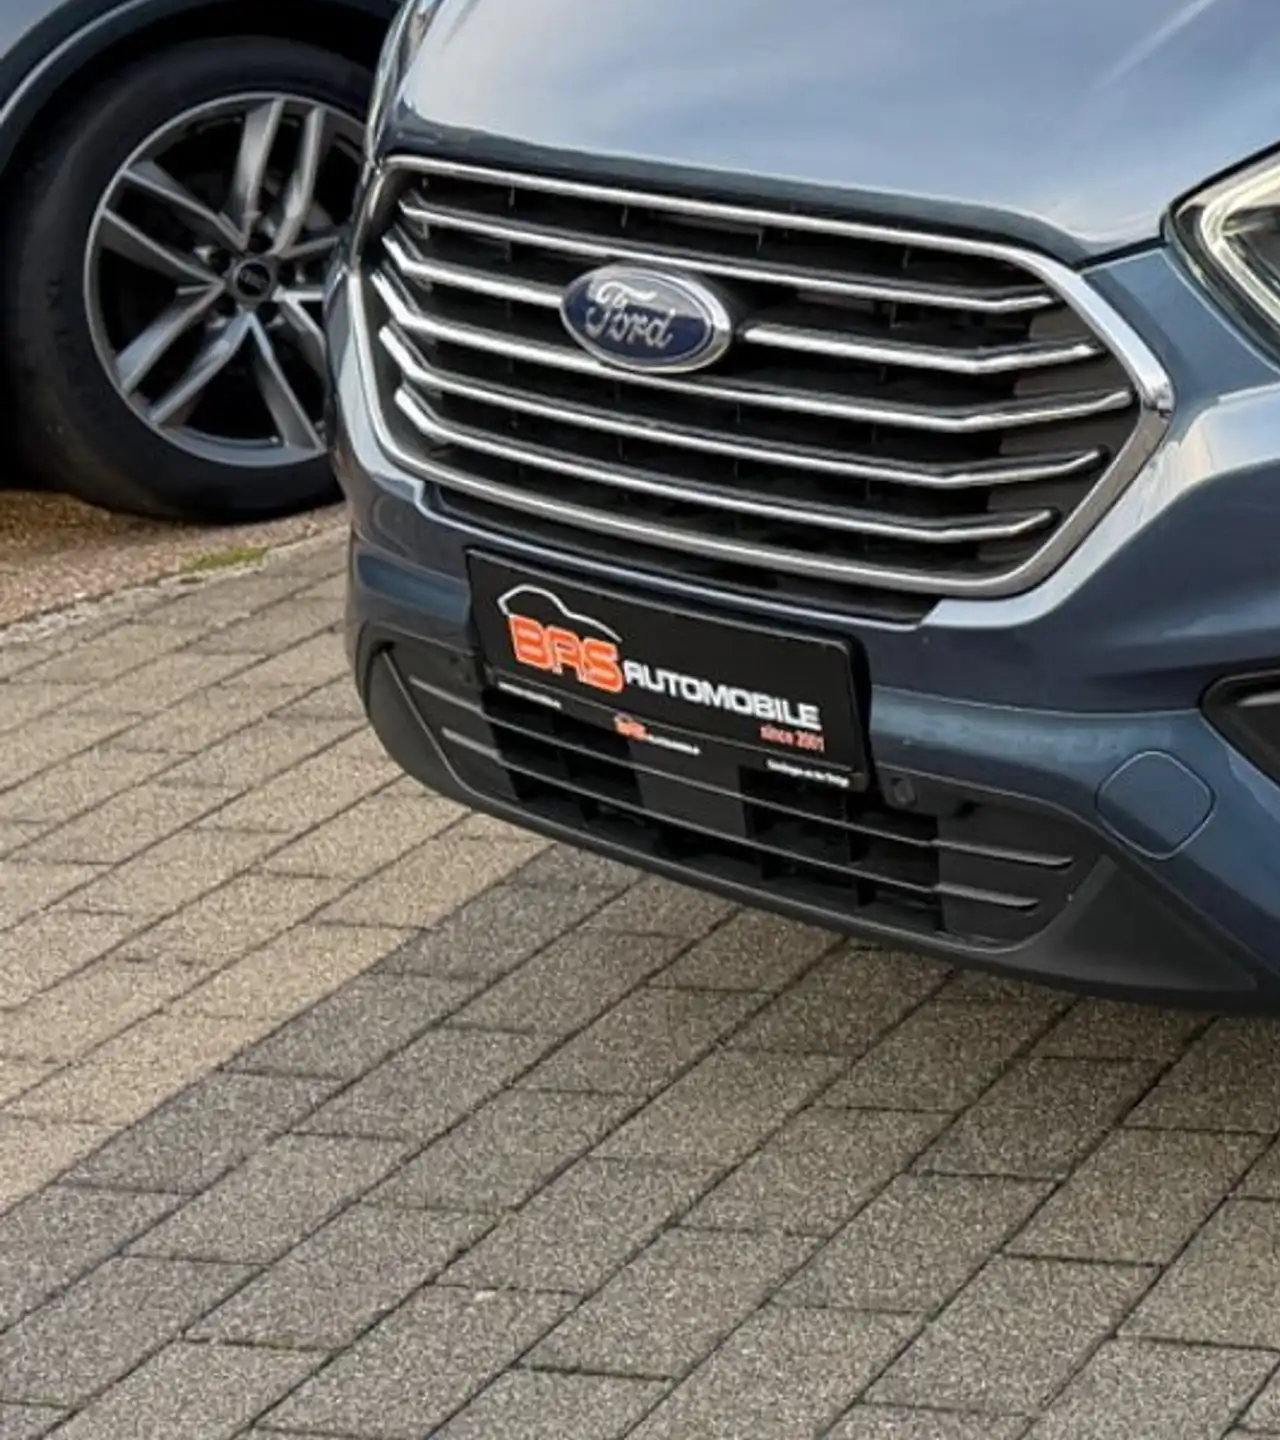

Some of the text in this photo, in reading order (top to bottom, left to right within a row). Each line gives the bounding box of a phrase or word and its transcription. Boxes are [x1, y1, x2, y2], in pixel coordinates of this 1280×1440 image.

[584, 279, 676, 350] Ford
[508, 615, 823, 732] BAS AUTOMOBILE
